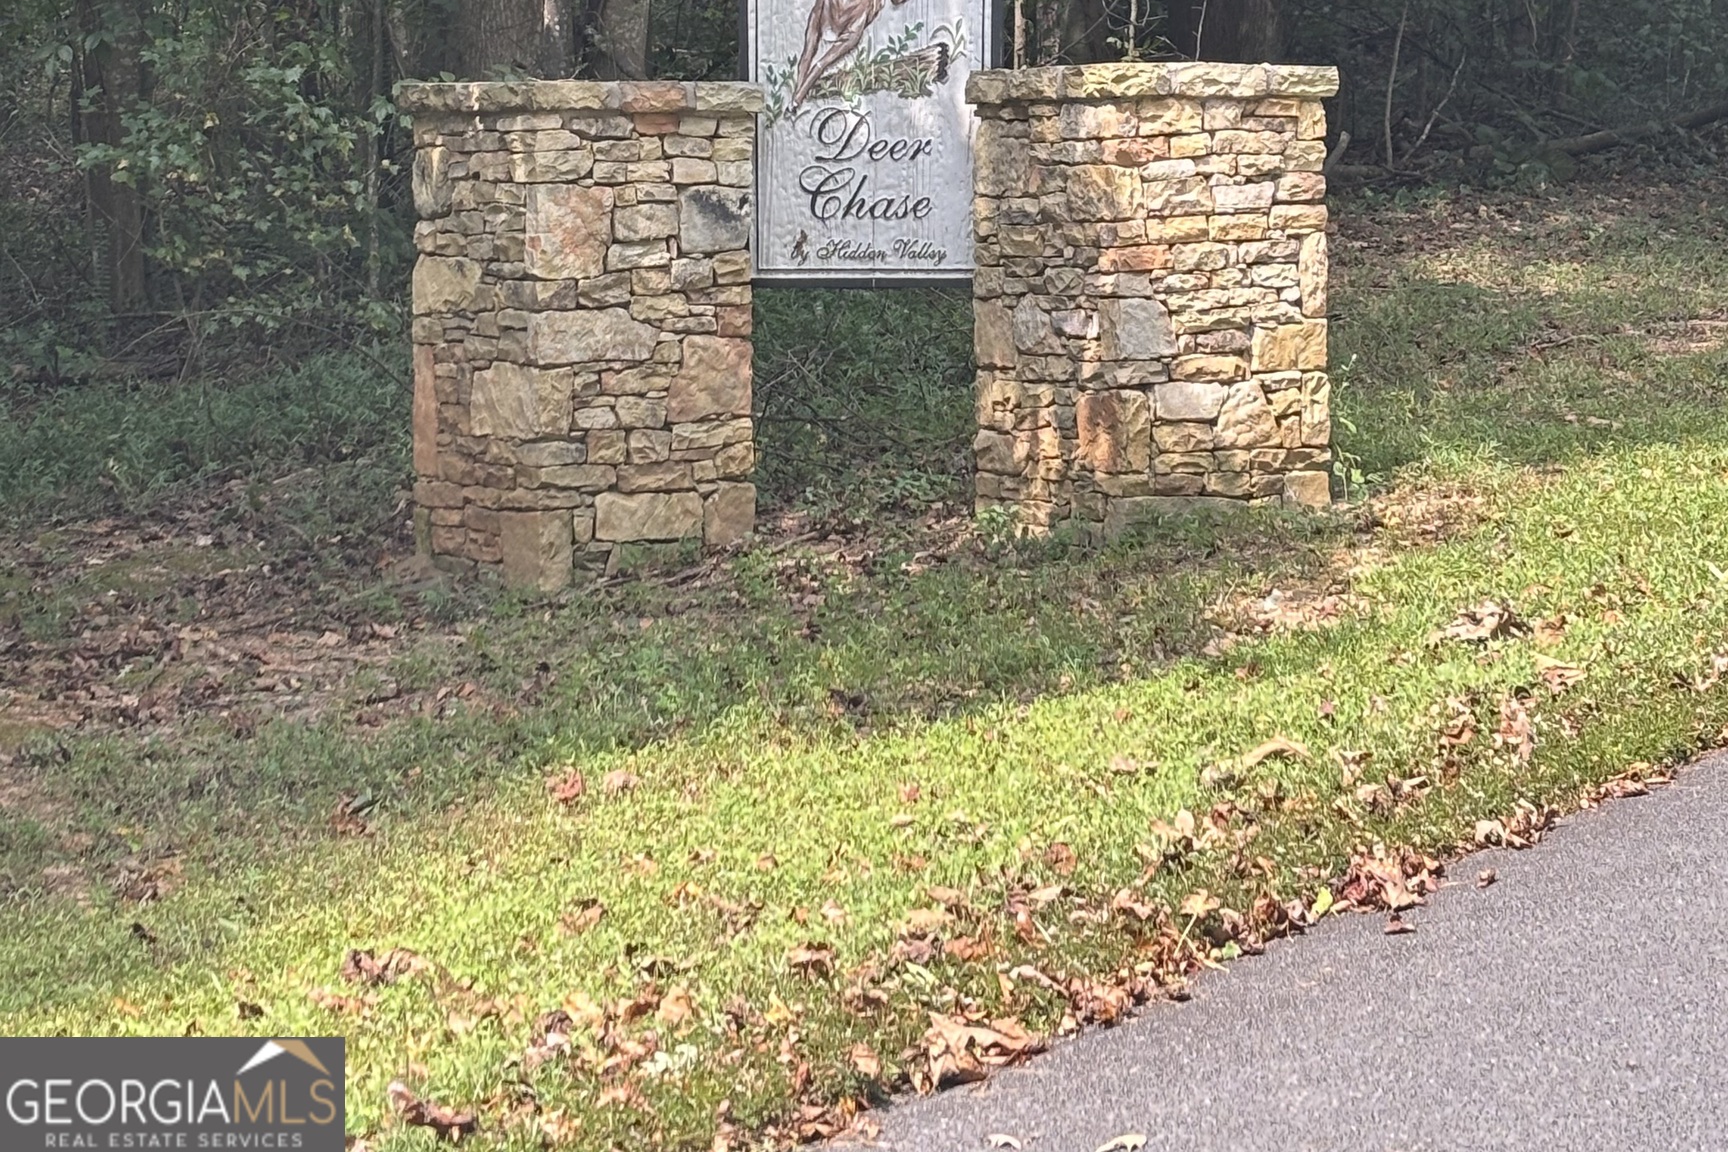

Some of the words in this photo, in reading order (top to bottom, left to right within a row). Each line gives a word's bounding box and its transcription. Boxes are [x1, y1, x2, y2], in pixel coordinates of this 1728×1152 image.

[809, 107, 933, 162] Deer
[799, 165, 933, 227] Chase
[790, 242, 810, 266] by
[816, 238, 887, 261] Hidden
[892, 238, 948, 266] Valley
